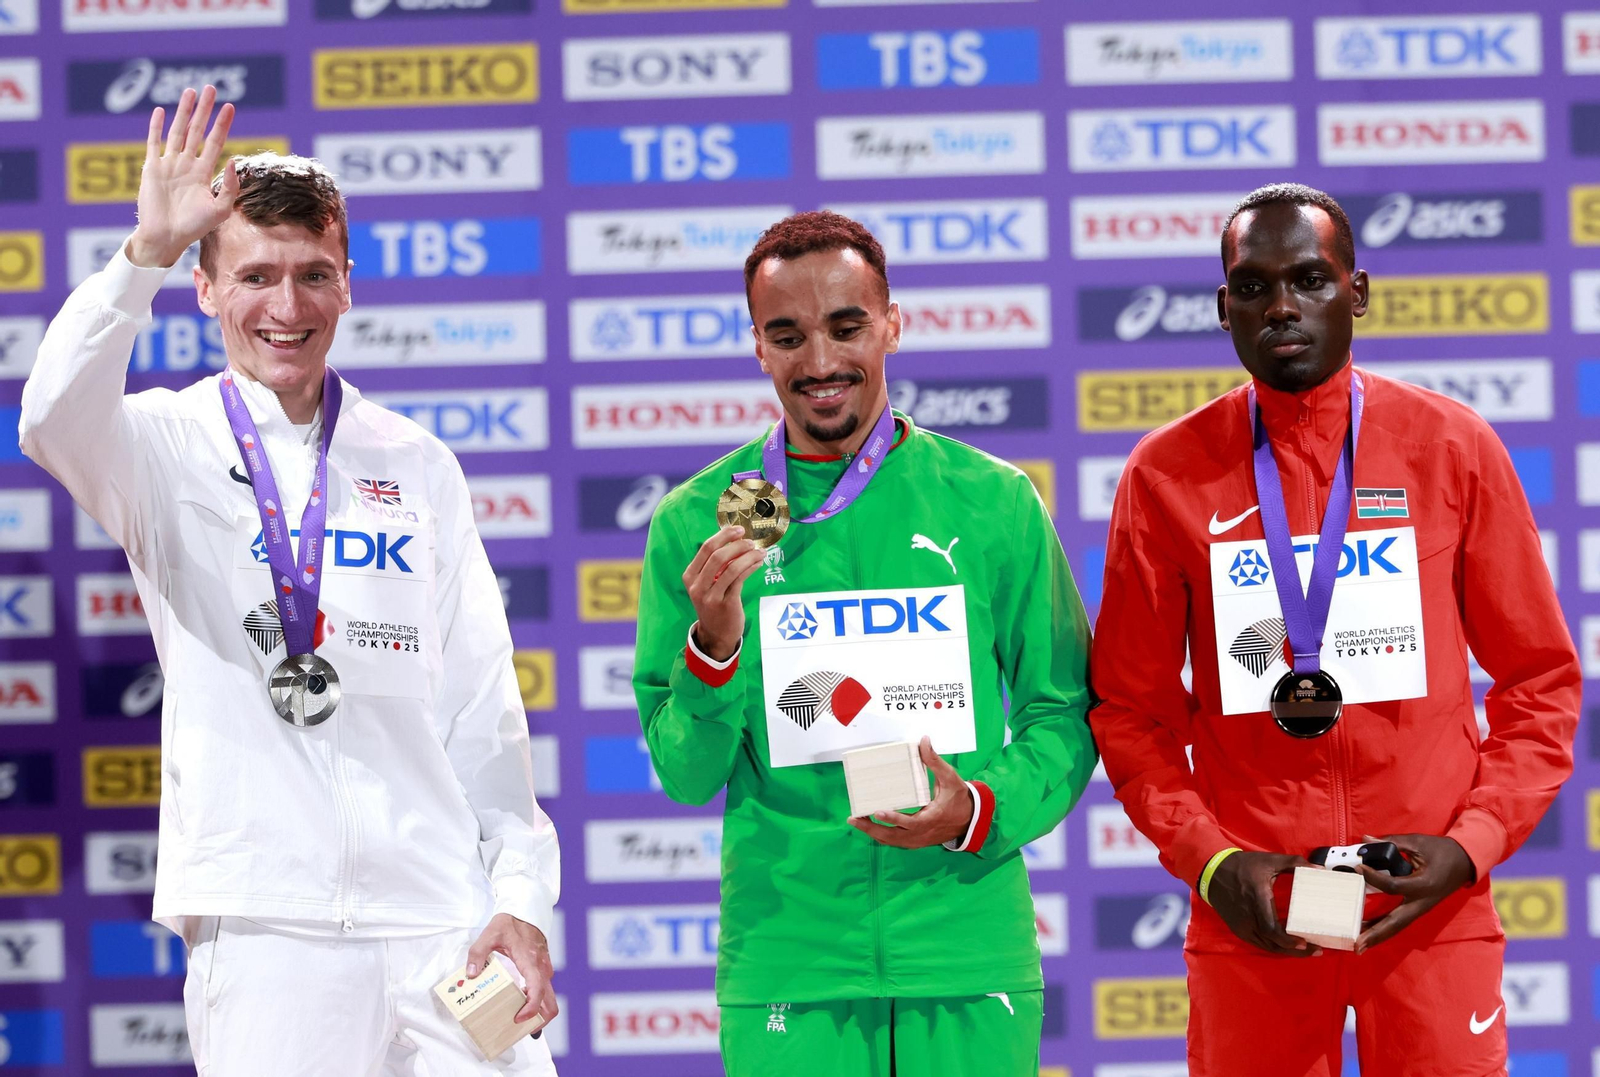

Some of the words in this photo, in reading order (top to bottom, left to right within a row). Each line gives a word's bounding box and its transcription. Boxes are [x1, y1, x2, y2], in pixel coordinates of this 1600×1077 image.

[868, 30, 987, 88] TBS
[1381, 26, 1516, 66] TDK
[324, 53, 528, 100] SEIKO
[586, 48, 763, 87] SONY
[1135, 117, 1271, 157] TDK
[1330, 115, 1531, 148] HONDA
[340, 143, 513, 182] SONY
[620, 124, 738, 182] TBS
[887, 212, 1021, 250] TDK
[1083, 212, 1221, 242] HON
[371, 220, 488, 277] TBS
[903, 303, 1035, 333] NDA
[585, 400, 781, 431] HONDA
[1089, 377, 1240, 423] SEI
[765, 574, 785, 585] FPA
[347, 620, 377, 630] WORLD
[379, 623, 419, 634] ATHLETICS
[816, 595, 951, 636] TDK
[346, 629, 419, 643] CHAMPIONSHIPS
[1334, 630, 1366, 639] WORLD
[1368, 626, 1415, 636] ATHLETICS
[1334, 634, 1416, 648] CHAMPIONSHIPS
[883, 691, 965, 702] CHAMPIONSHIPS
[917, 683, 964, 691] ATHLETICS
[603, 1006, 718, 1039] HON
[766, 1022, 787, 1033] FPA
